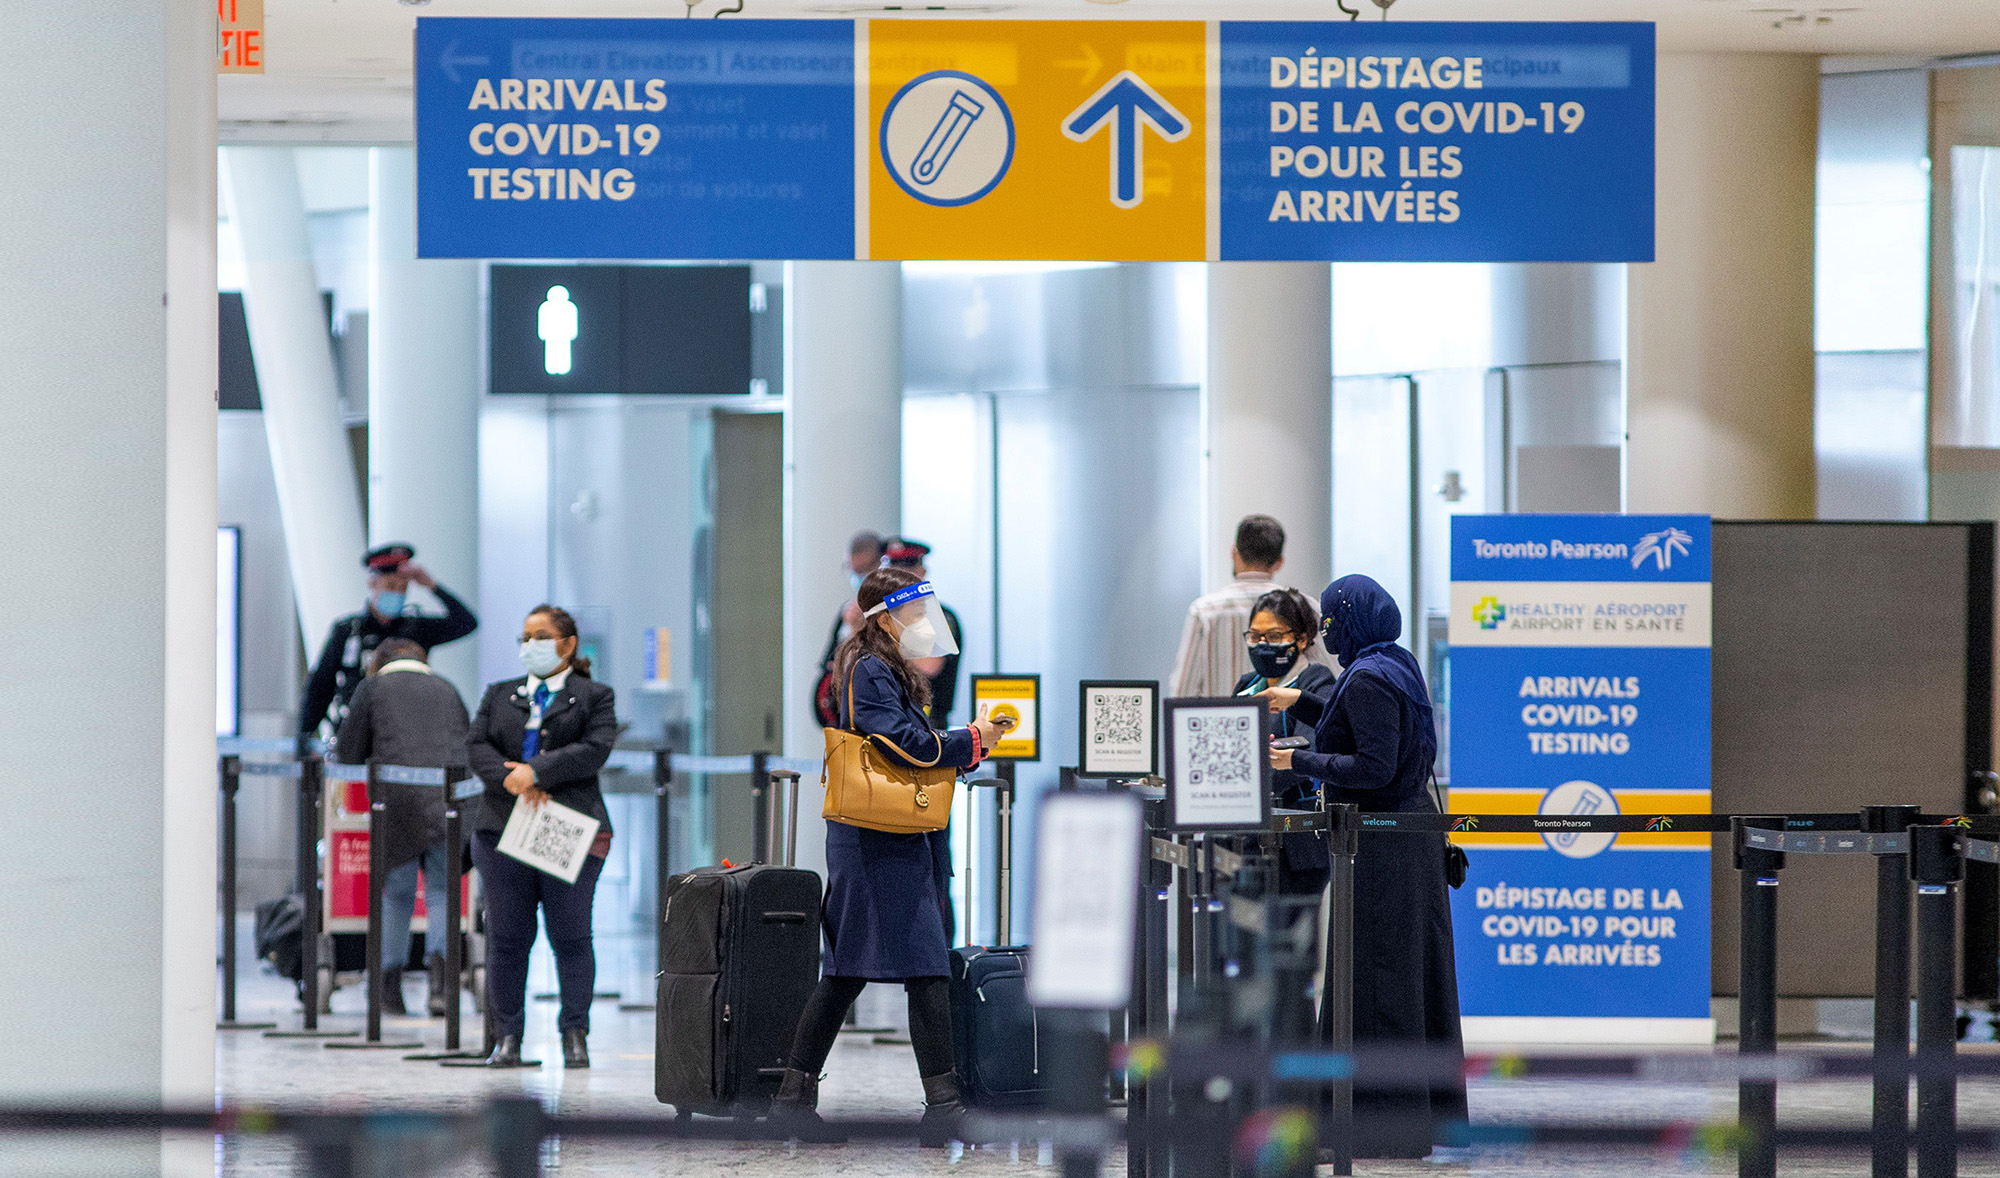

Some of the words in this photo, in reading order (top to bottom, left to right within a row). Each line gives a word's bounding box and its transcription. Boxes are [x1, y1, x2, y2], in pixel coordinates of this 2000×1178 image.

[1270, 46, 1483, 90] DÉPISTAGE
[468, 78, 668, 112] ARRIVALS
[1270, 101, 1319, 133] DE
[1333, 101, 1383, 133] LA
[1394, 101, 1585, 134] COVID-19
[469, 122, 661, 156] COVID-19
[1270, 145, 1386, 178] POUR
[1399, 145, 1463, 179] LES
[467, 167, 636, 201] TESTING
[1268, 180, 1460, 222] ARRIVÉES
[1472, 538, 1548, 559] Toronto
[1551, 539, 1628, 559] Pearson
[1508, 603, 1585, 616] HEALTHY
[1510, 618, 1584, 631] AIRPORT
[1593, 618, 1617, 631] EN
[1519, 676, 1640, 698] ARRIVALS
[1521, 704, 1638, 726] COVID-19
[1527, 732, 1630, 755] TESTING
[1362, 818, 1397, 826] welcome
[1533, 819, 1562, 827] Toronto
[1562, 819, 1592, 827] Pearson
[1476, 881, 1607, 910] DÉPISTAGE
[1613, 888, 1645, 910] DE
[1651, 888, 1684, 910] LA
[1482, 915, 1599, 938] COVID-19
[1604, 916, 1677, 938] POUR
[1498, 943, 1538, 966] LES
[1543, 939, 1662, 967] ARRIVÉES
